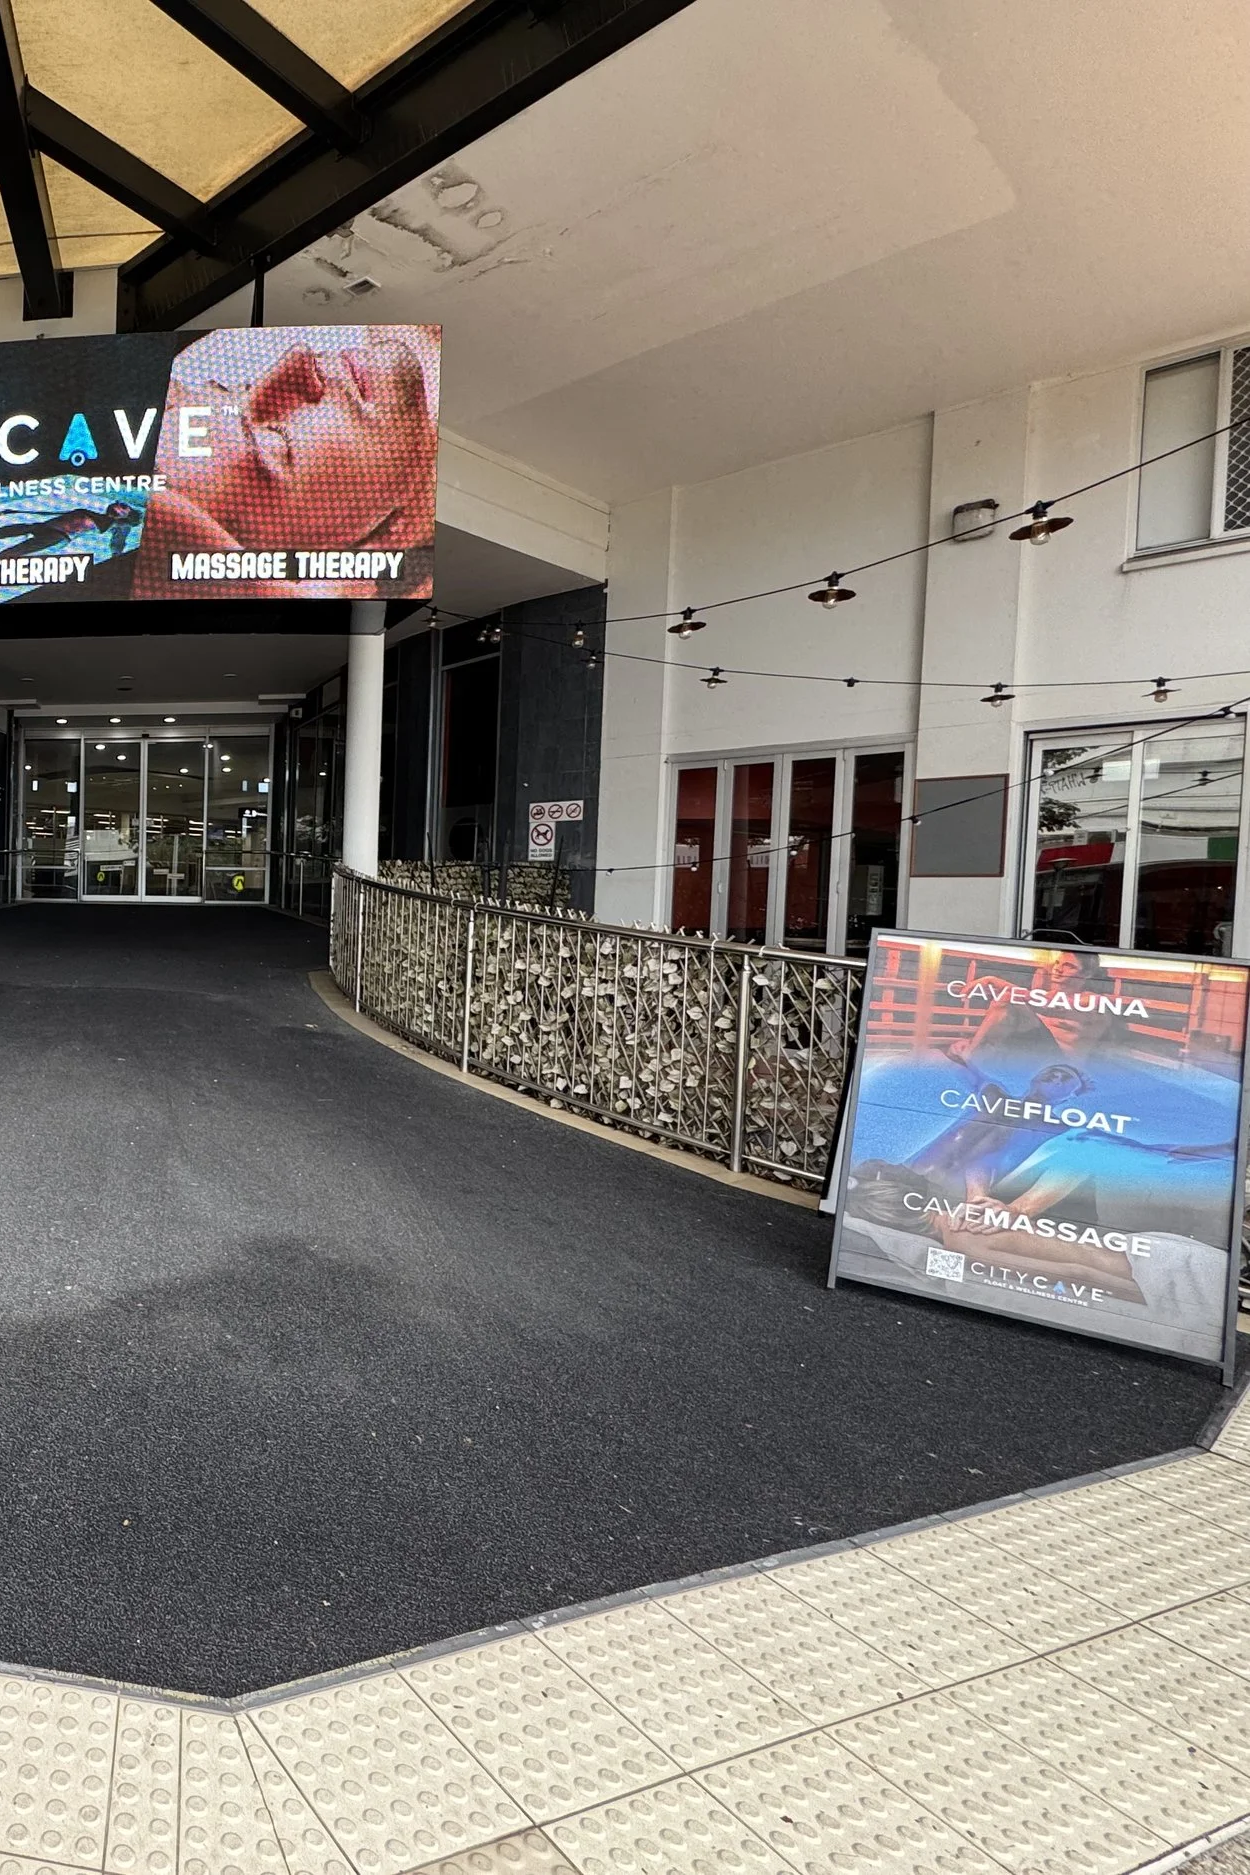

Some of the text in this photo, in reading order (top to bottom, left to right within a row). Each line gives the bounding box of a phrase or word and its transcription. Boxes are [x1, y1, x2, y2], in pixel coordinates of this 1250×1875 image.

[73, 474, 167, 495] CENTRE
[171, 551, 403, 581] MASSAGE THERAPY
[947, 980, 1150, 1019] CAVESAUNA
[940, 1089, 1132, 1134] CAVEFLOAT
[902, 1192, 1151, 1258] CAVEMASSAGE
[984, 1279, 1007, 1288] FLOAT
[1015, 1284, 1056, 1300] WELLNESS
[1057, 1294, 1088, 1307] CENTRE
